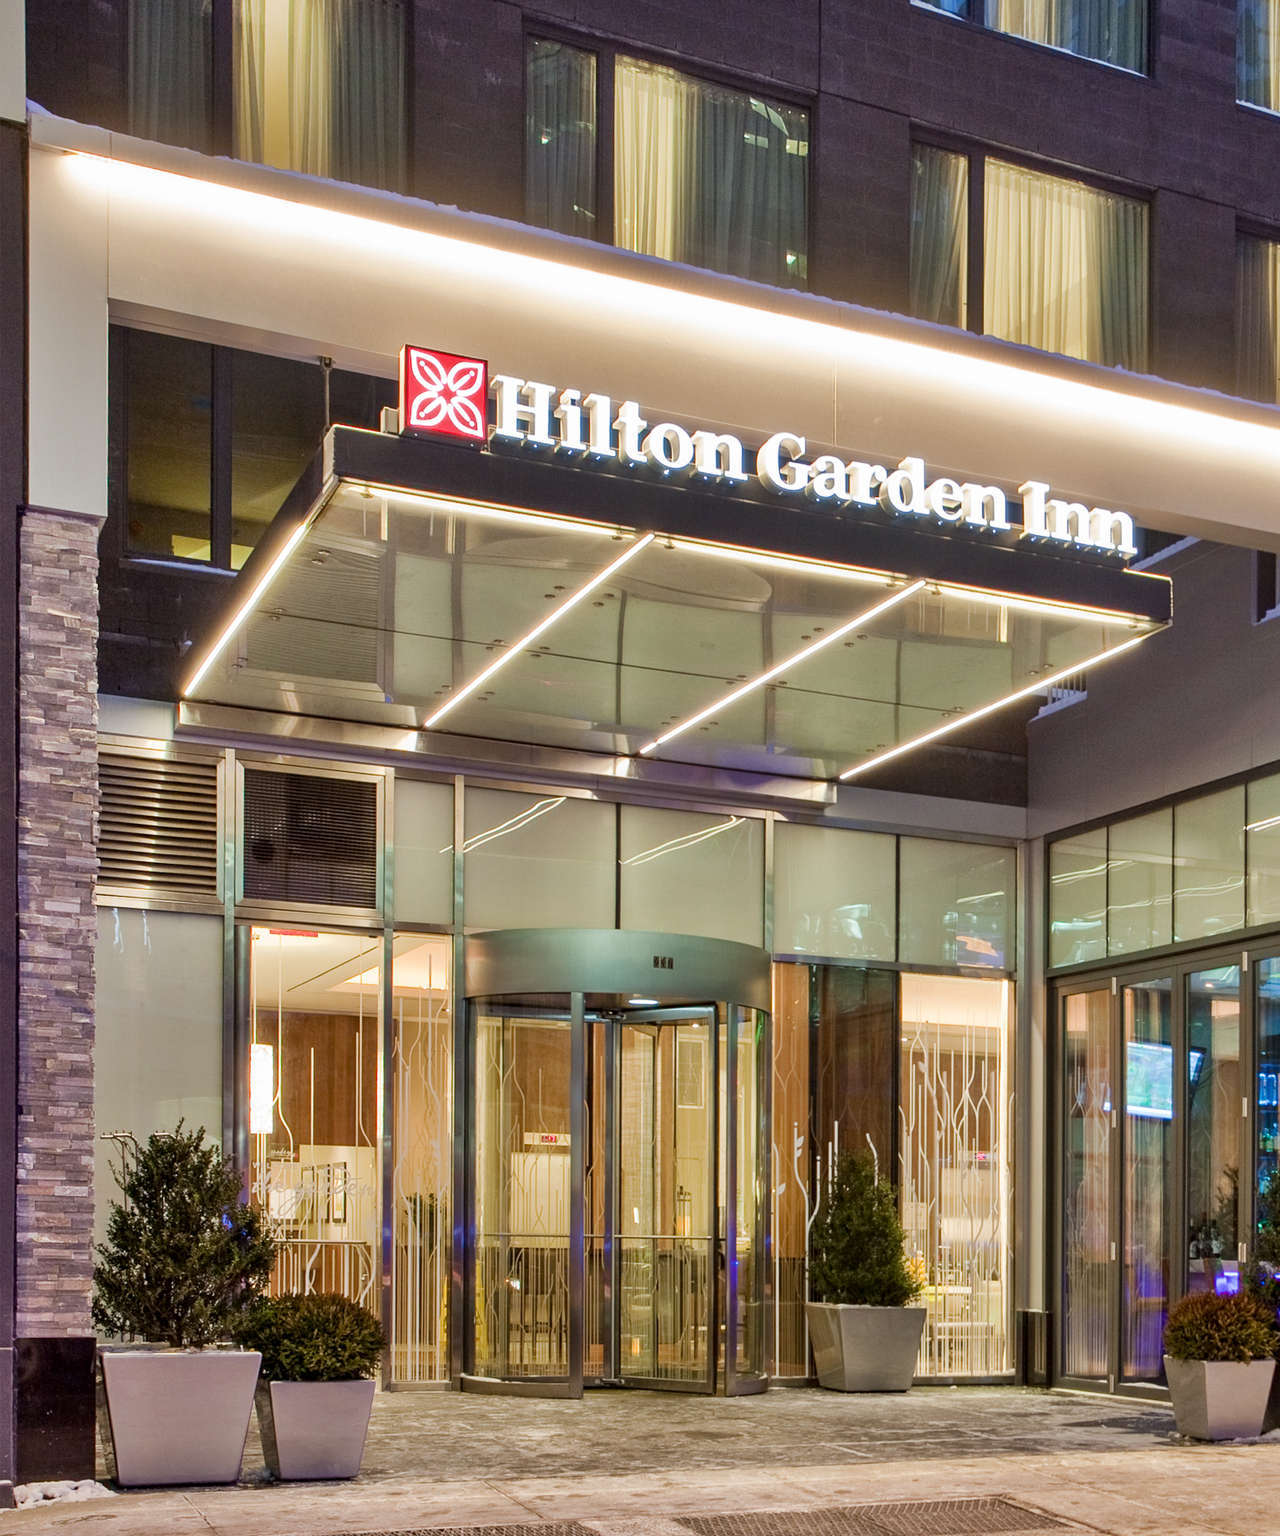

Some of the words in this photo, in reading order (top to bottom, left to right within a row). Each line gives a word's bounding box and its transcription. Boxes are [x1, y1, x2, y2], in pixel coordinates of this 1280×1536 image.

[489, 374, 748, 481] Hilton
[756, 431, 1011, 531] Garden
[1018, 480, 1138, 558] Inn
